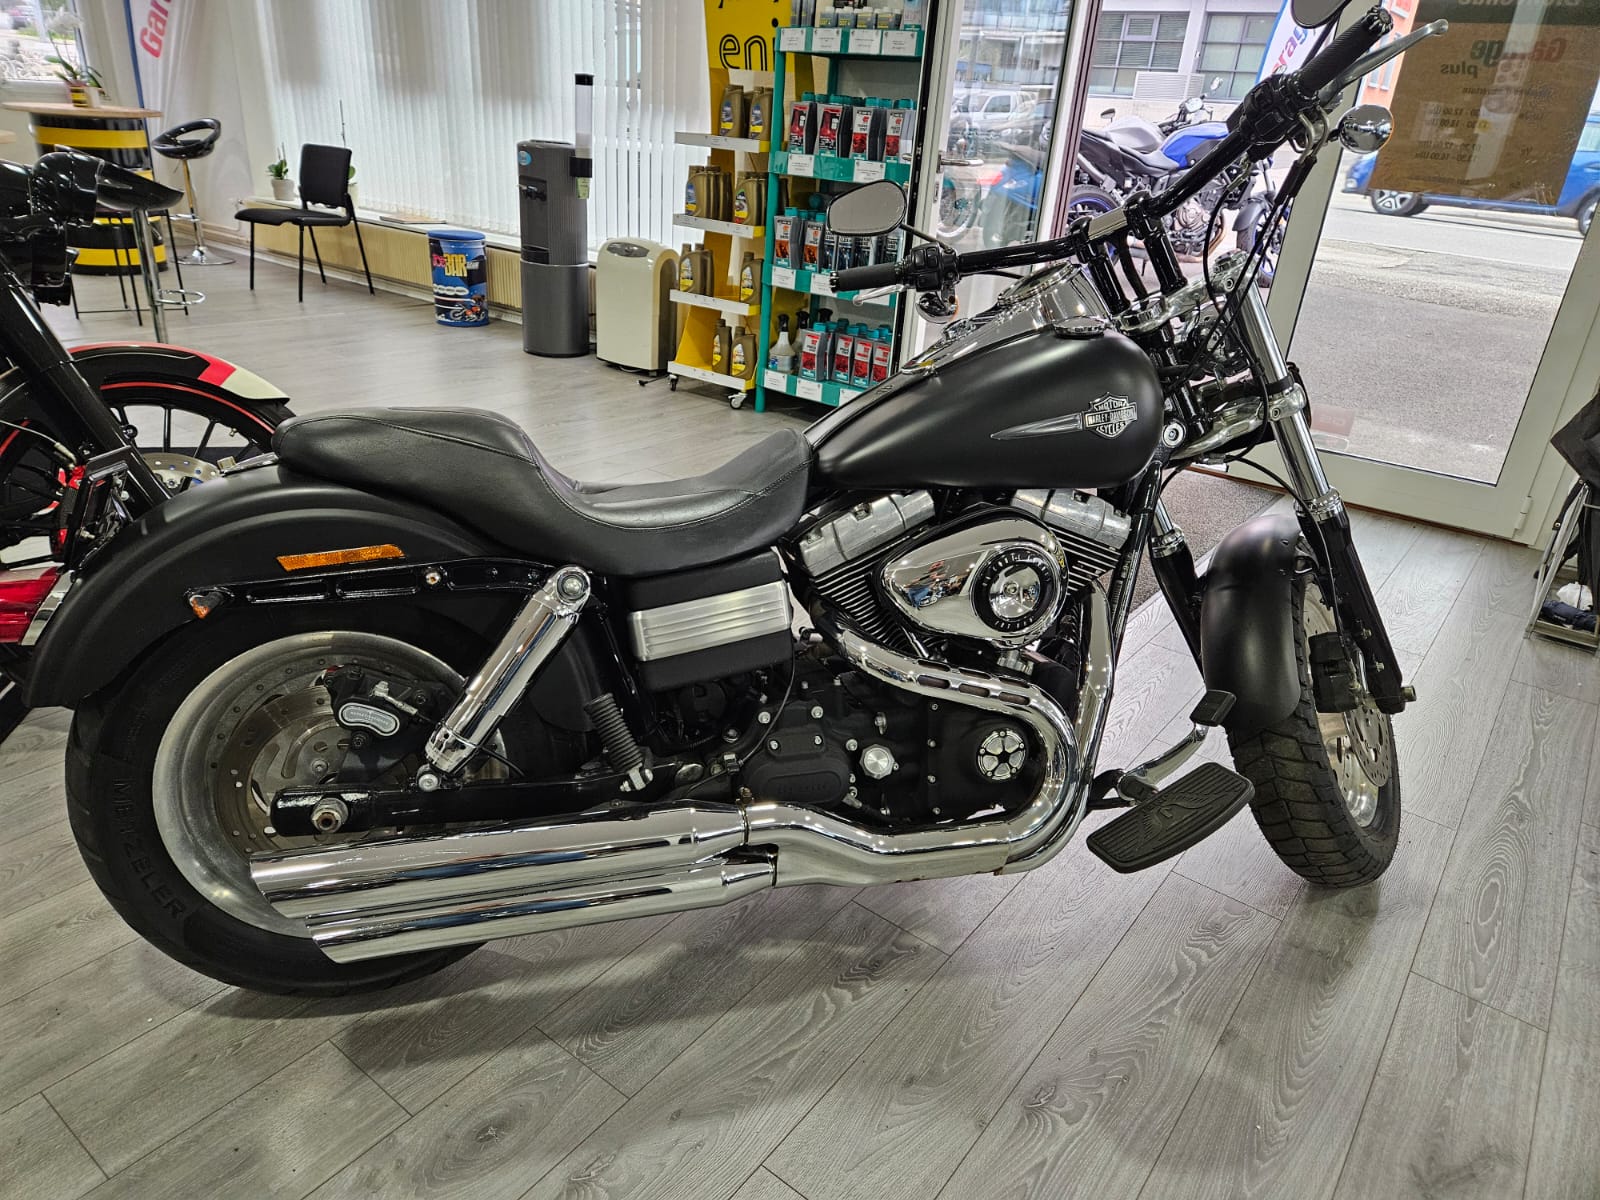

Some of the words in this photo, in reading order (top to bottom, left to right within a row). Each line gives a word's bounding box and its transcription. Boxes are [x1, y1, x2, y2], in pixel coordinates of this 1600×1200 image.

[141, 0, 172, 58] Gar
[443, 252, 468, 277] BAR
[1094, 399, 1127, 411] MOTOR
[1097, 421, 1126, 435] CYCLES
